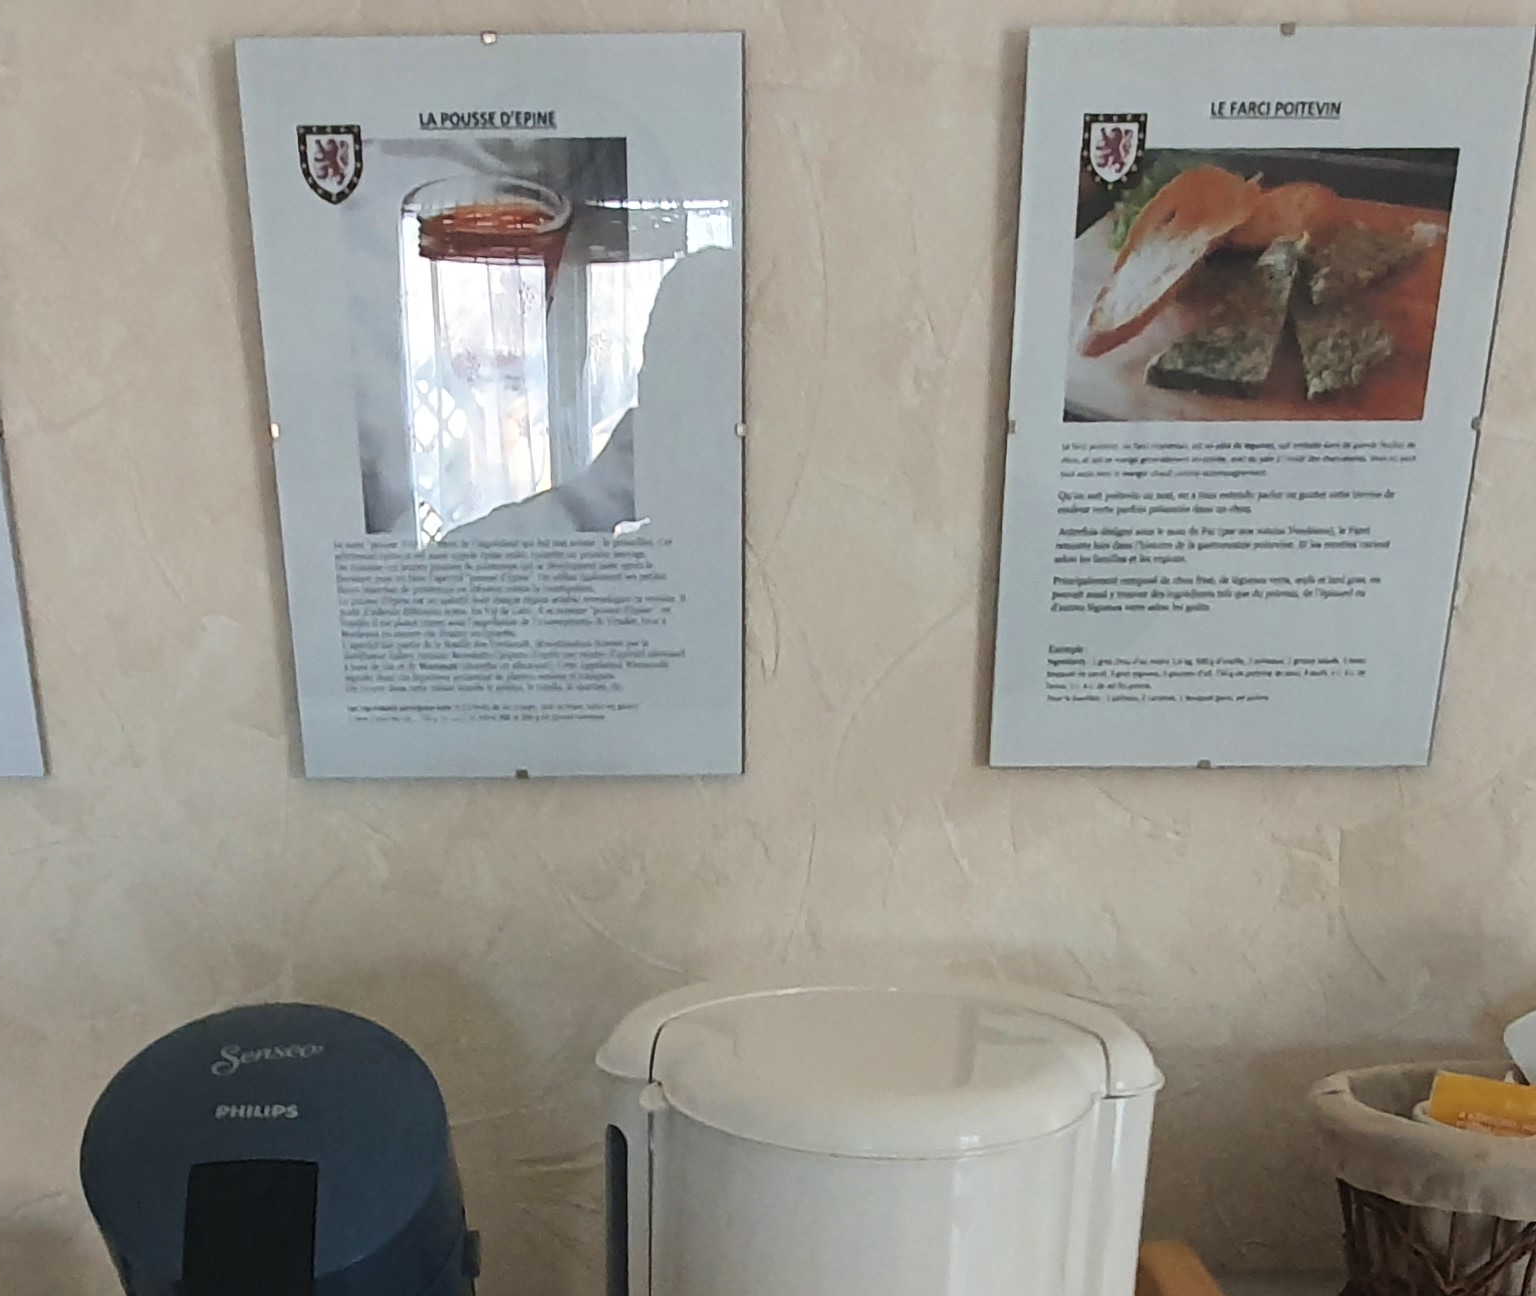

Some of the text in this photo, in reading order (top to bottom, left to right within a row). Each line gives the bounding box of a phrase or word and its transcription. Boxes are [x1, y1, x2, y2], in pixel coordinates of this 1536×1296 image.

[1210, 100, 1341, 118] LE FARCI POITEVIN
[419, 110, 557, 129] LA POUSSE D'EPINE
[210, 1043, 324, 1076] Senseo
[215, 1103, 299, 1120] PHILIPS
